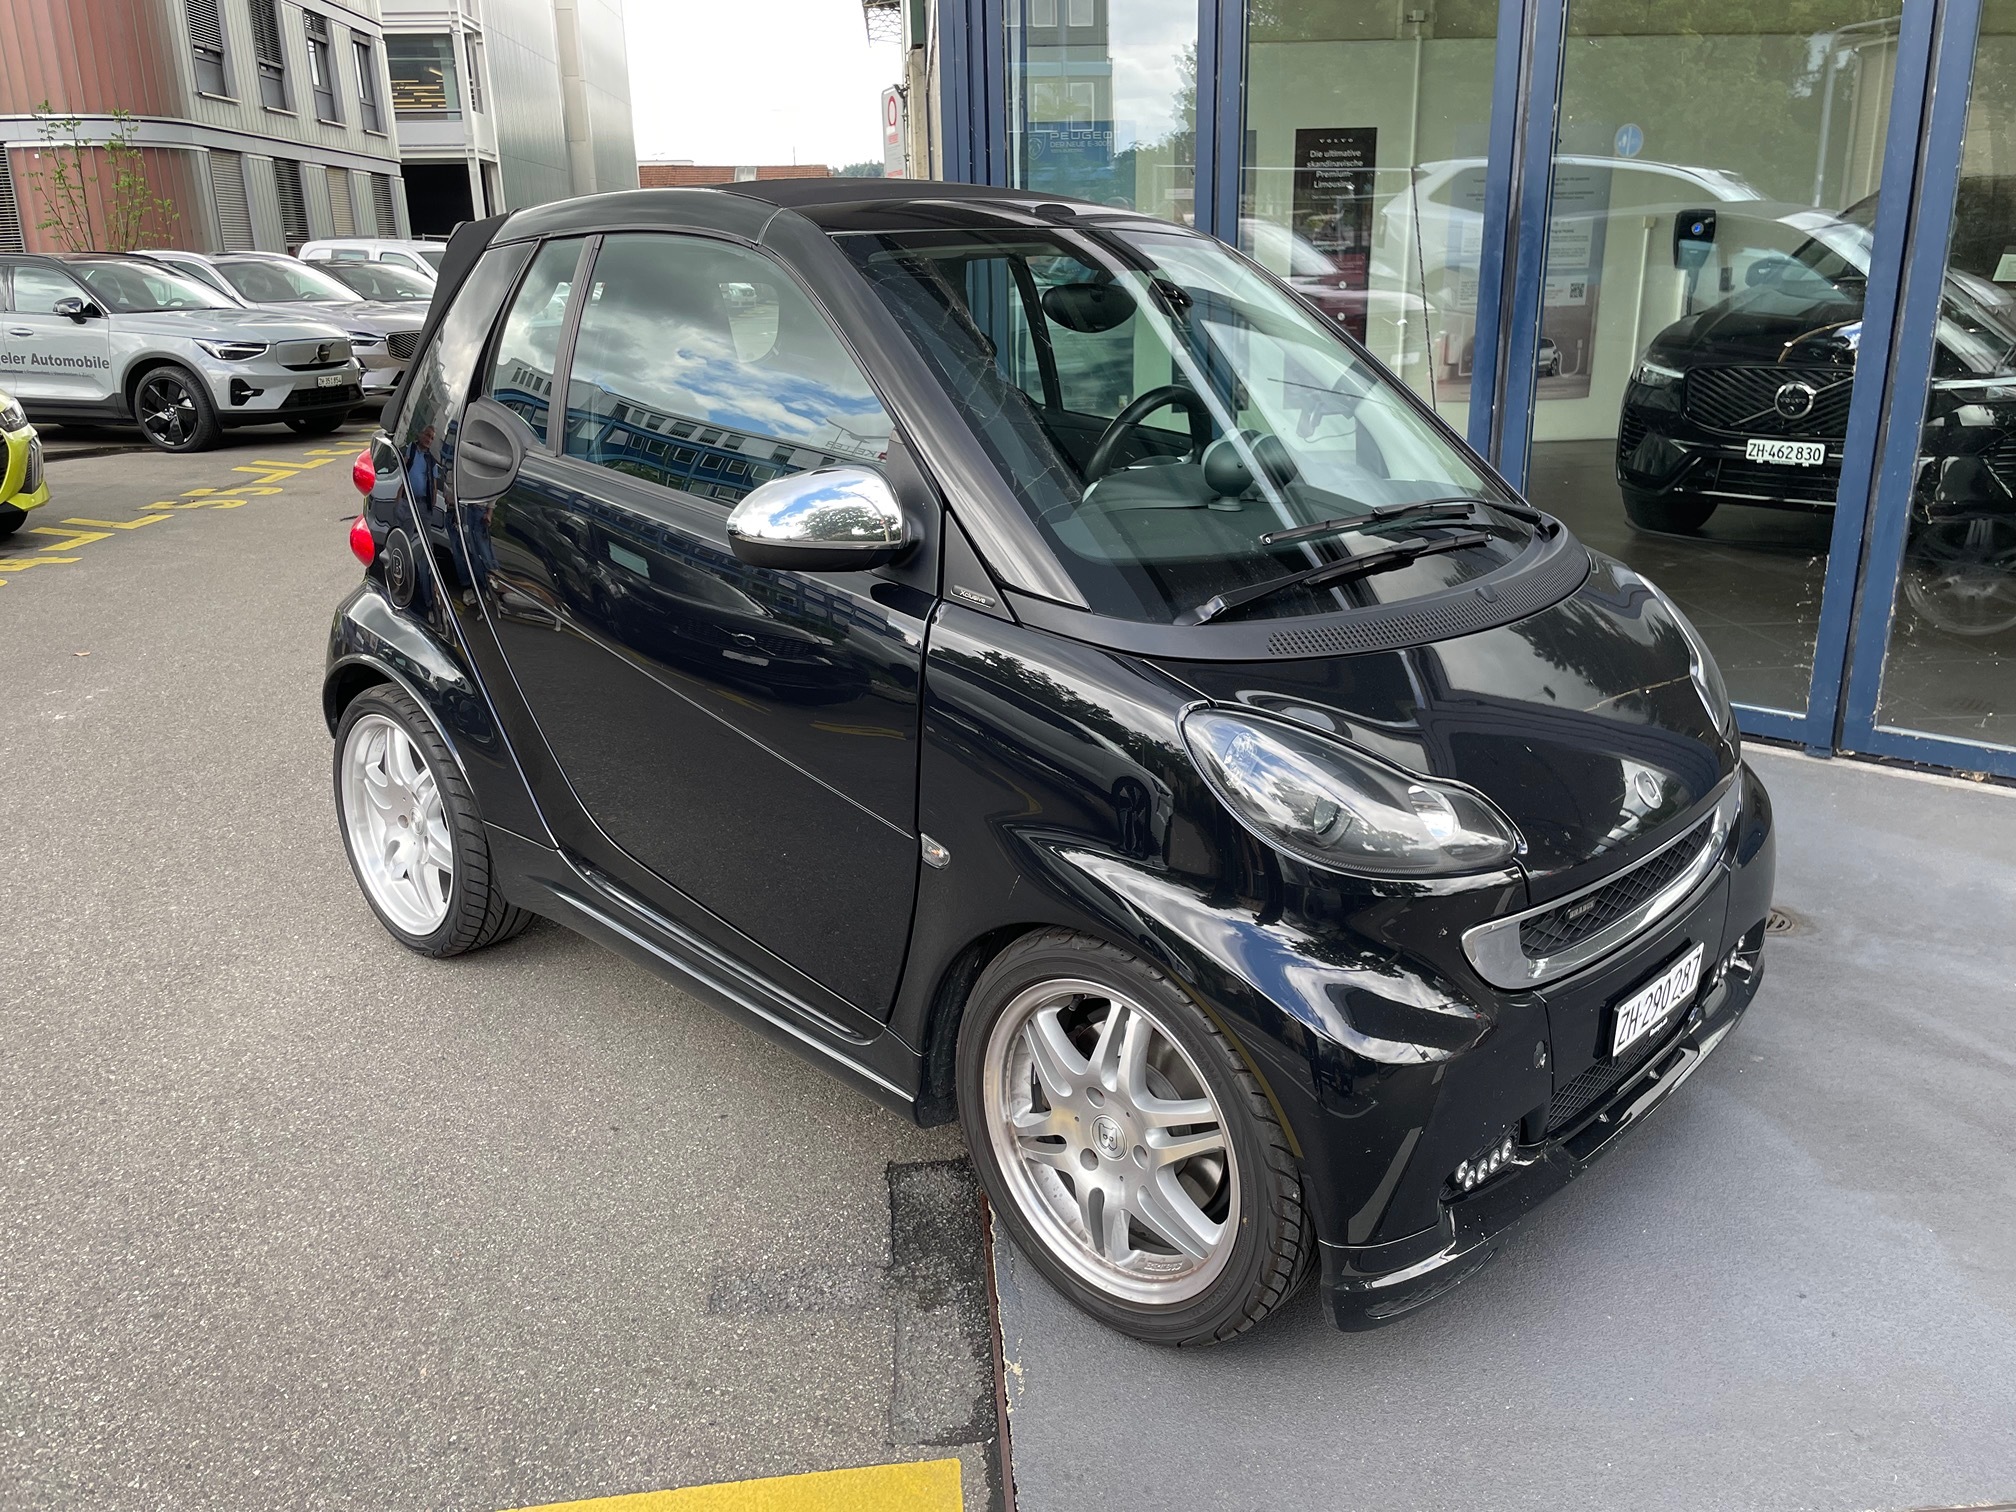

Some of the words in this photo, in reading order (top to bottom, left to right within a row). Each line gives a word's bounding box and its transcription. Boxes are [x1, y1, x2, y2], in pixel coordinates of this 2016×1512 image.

[1050, 131, 1113, 140] PEUGEO
[1309, 150, 1323, 159] Die
[1324, 148, 1362, 158] ultimative
[1306, 158, 1364, 169] skandinavische
[1315, 170, 1353, 179] Premium-
[0, 351, 26, 365] eler
[30, 352, 110, 370] Automobile
